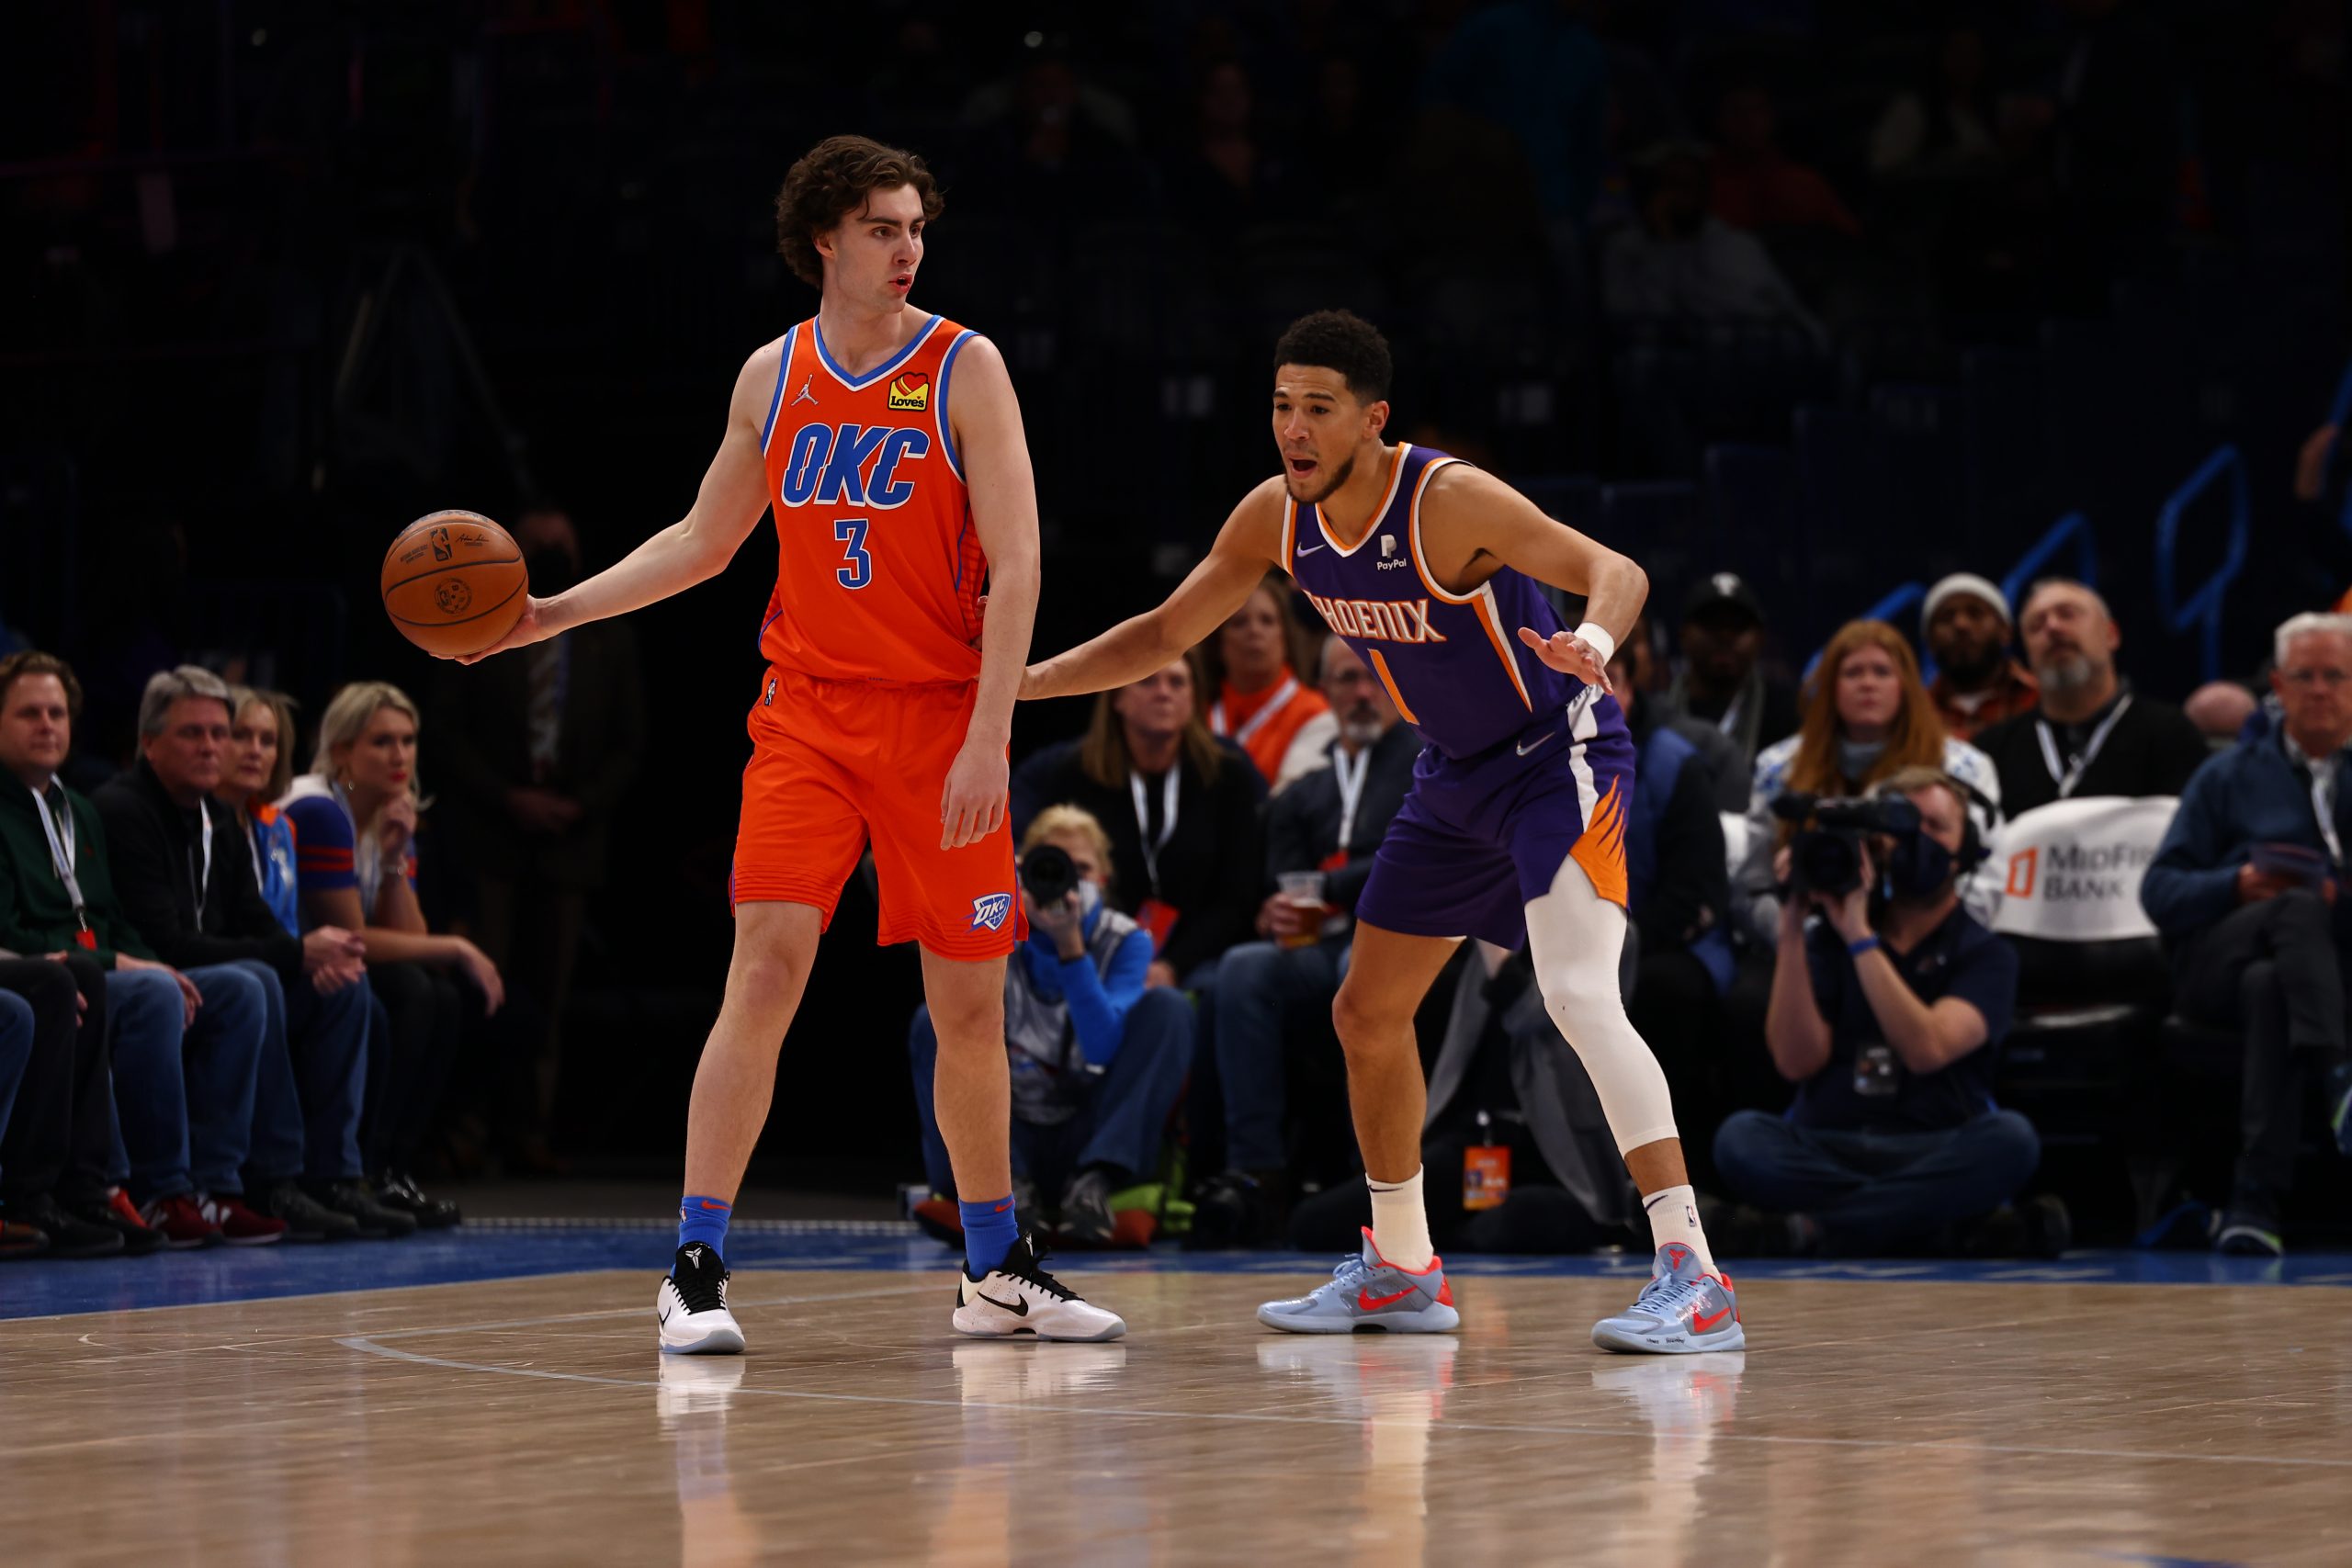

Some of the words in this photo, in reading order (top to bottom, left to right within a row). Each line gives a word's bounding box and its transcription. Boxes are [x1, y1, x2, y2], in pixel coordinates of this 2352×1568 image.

[781, 423, 931, 510] OKC
[833, 518, 872, 590] 3
[1376, 558, 1408, 571] PayPal
[1367, 648, 1420, 726] 1
[972, 897, 1007, 926] OKC
[2043, 874, 2124, 900] BANK
